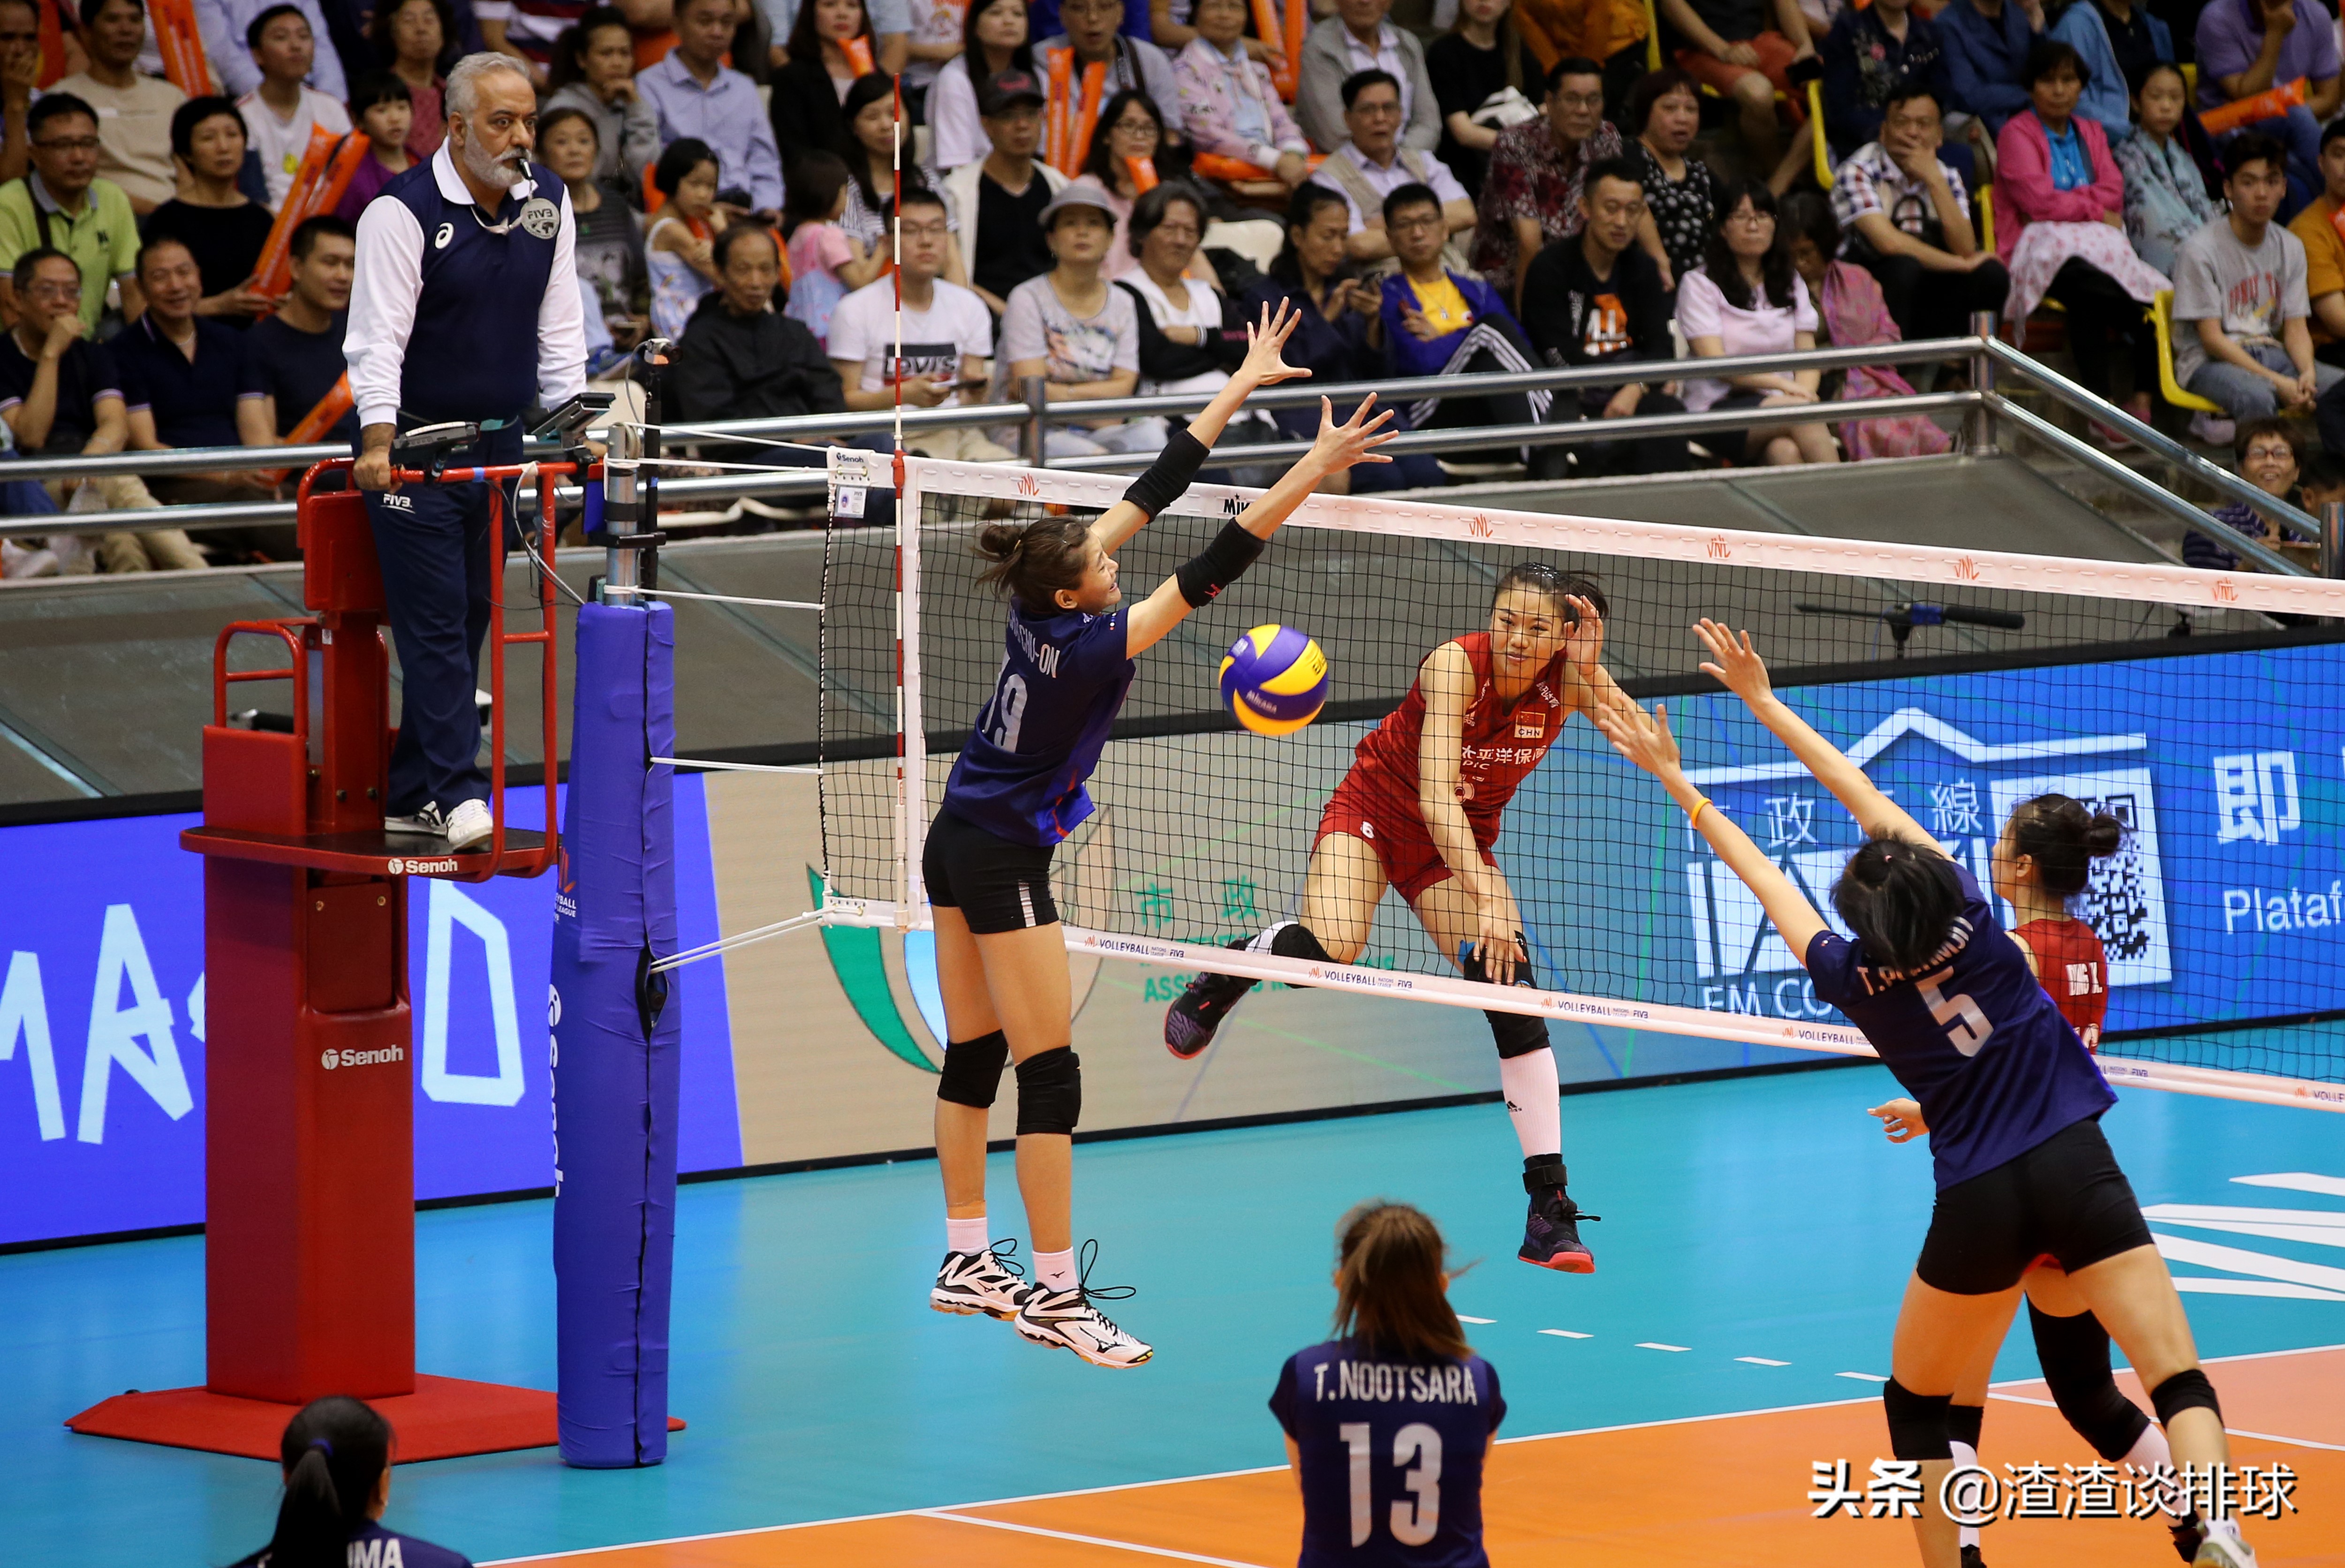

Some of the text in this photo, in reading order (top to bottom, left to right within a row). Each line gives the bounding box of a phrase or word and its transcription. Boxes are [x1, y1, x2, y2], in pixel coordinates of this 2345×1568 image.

[528, 209, 552, 219] FIVB
[842, 454, 864, 463] Senoh
[1462, 760, 1490, 770] PIC
[1360, 821, 1375, 839] 6
[406, 858, 458, 874] Senoh
[2224, 880, 2345, 935] Plataf
[1100, 939, 1149, 955] VOLLEYBALL
[1170, 949, 1184, 957] FIVB
[1324, 970, 1376, 986] VOLLEYBALL
[1398, 980, 1412, 988] FIVB
[1558, 1000, 1611, 1016] VOLLEYBALL
[1633, 1010, 1648, 1018] FIVB
[1915, 965, 1994, 1057] 5
[1799, 1030, 1854, 1045] VOLLEYBALL
[340, 1044, 404, 1067] Senoh
[1339, 1422, 1443, 1548] 13
